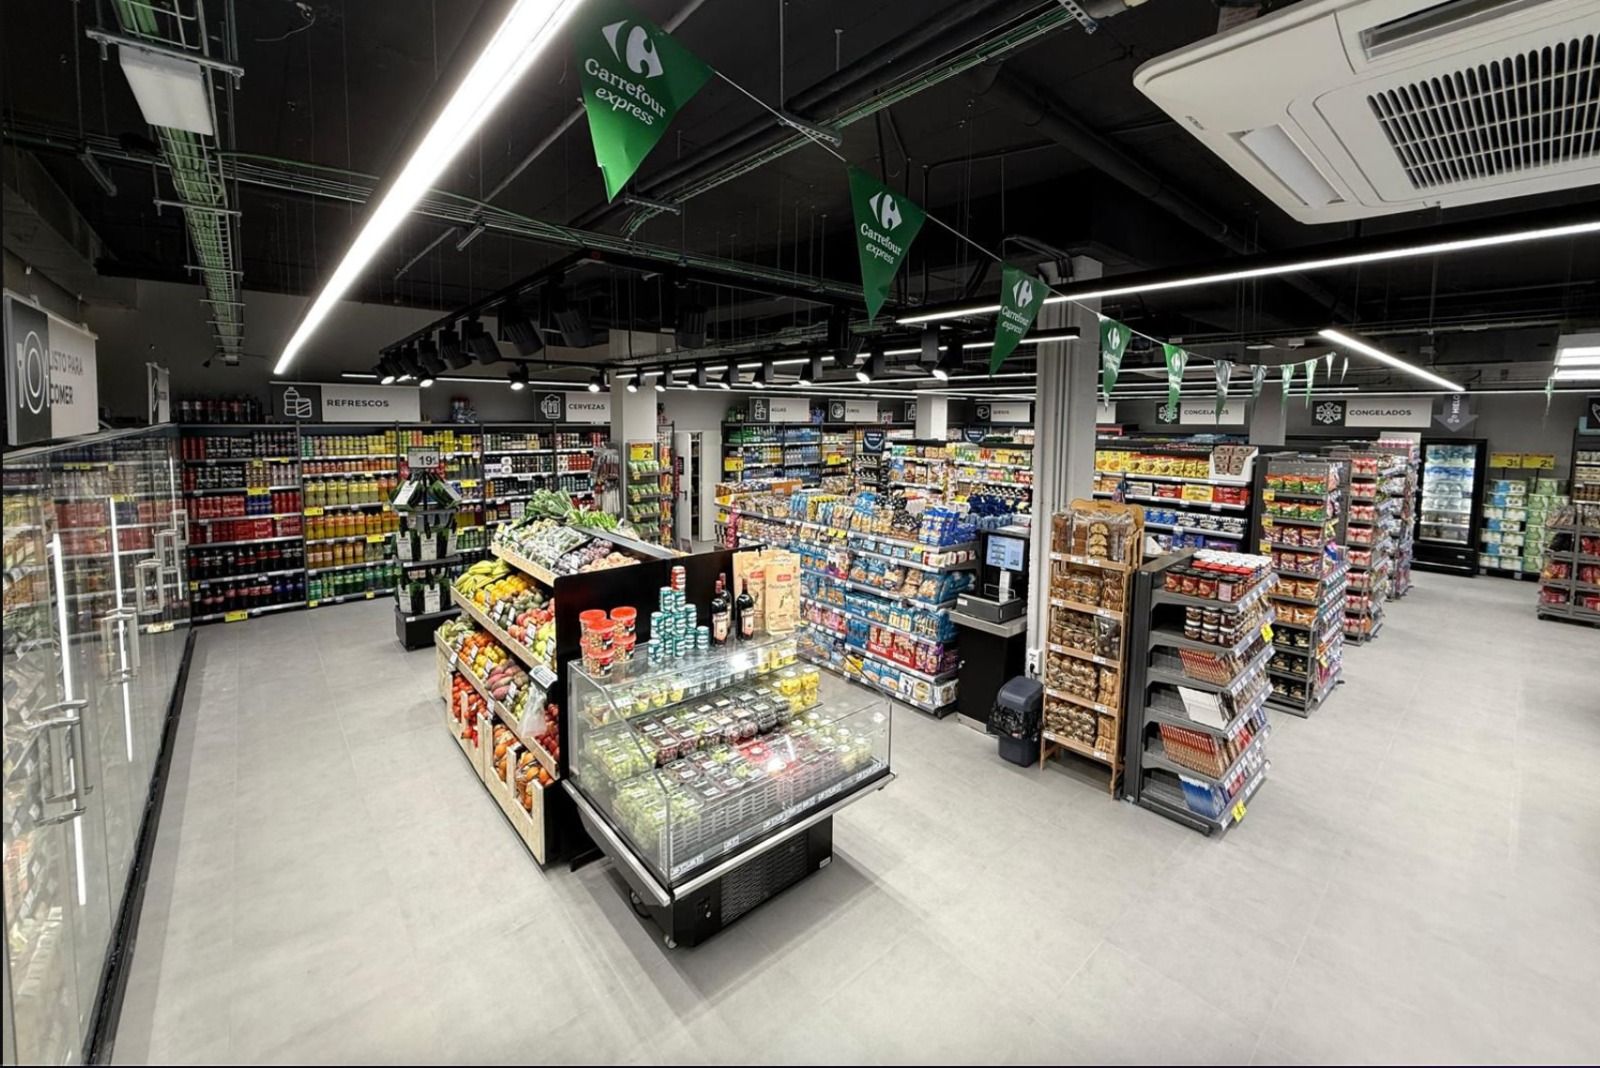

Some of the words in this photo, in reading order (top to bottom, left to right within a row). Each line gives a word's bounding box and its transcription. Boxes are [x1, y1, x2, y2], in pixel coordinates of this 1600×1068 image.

[585, 58, 666, 118] Carrefour
[595, 87, 655, 126] express
[860, 223, 902, 257] Carrefour
[865, 243, 895, 265] express
[326, 398, 390, 408] REFRESCOS
[568, 403, 606, 411] CERVEZAS
